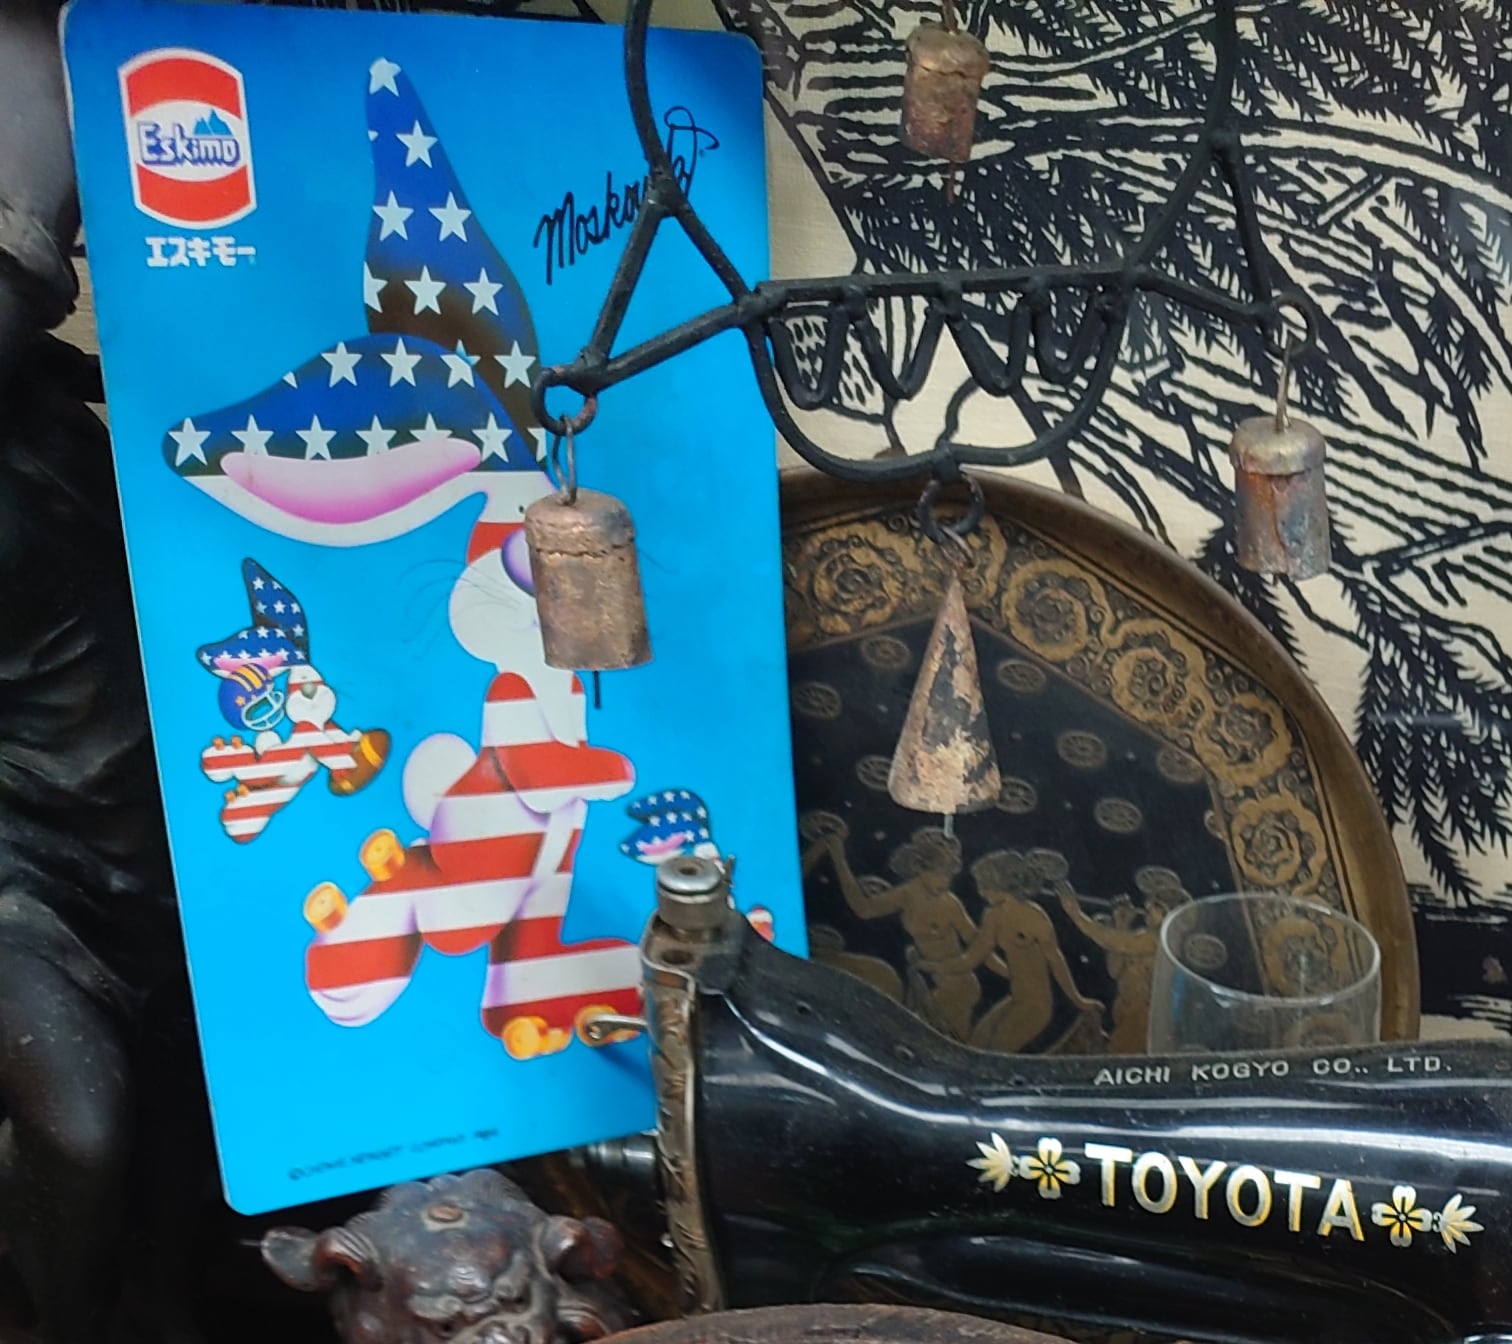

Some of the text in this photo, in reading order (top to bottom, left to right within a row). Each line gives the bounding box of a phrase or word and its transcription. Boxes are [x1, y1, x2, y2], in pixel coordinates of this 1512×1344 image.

[138, 120, 242, 167] Eskimo
[145, 236, 257, 268] エスキモー
[1094, 1066, 1171, 1086] AICHI
[1191, 1060, 1290, 1081] KOGYO
[1387, 1056, 1452, 1073] LTD.
[1085, 1142, 1365, 1242] TOYOTA
